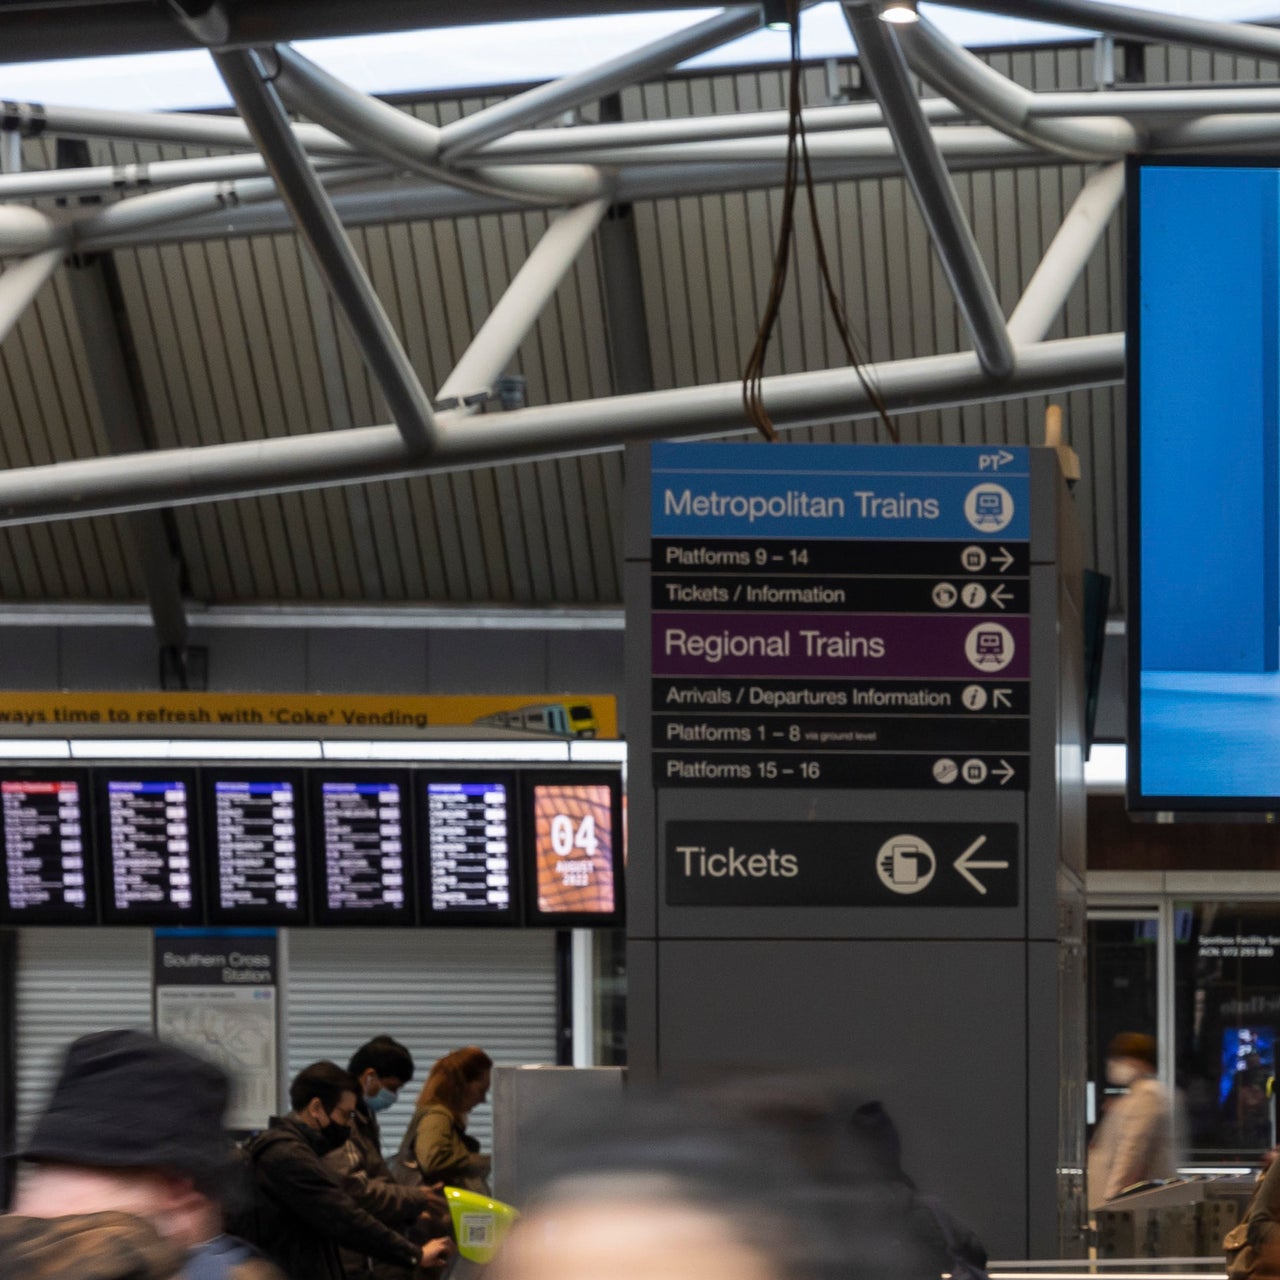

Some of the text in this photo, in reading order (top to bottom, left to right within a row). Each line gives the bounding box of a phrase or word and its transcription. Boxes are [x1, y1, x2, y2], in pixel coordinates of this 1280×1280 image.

[664, 489, 940, 522] Metropolitan Trains
[665, 547, 751, 566] Platforms
[755, 548, 767, 566] 9
[789, 549, 809, 566] 14
[666, 584, 729, 602] Tickets
[746, 585, 846, 604] Information
[665, 629, 886, 662] Regional Trains
[666, 687, 732, 704] Arrivals
[749, 687, 848, 708] Departures
[852, 689, 951, 706] Information
[54, 708, 101, 723] time
[107, 709, 131, 724] to
[136, 708, 212, 724] refresh
[217, 708, 264, 724] with
[341, 709, 428, 729] Vending
[666, 724, 751, 742] Platforms
[757, 725, 765, 741] 1
[788, 725, 801, 742] 8
[666, 760, 752, 779] Platforms
[757, 761, 778, 779] 15
[799, 761, 821, 779] 16
[551, 814, 599, 857] 04
[555, 860, 595, 873] AUGUST
[675, 846, 800, 878] Tickets
[163, 951, 271, 968] Southern Cross
[222, 966, 272, 983] Station
